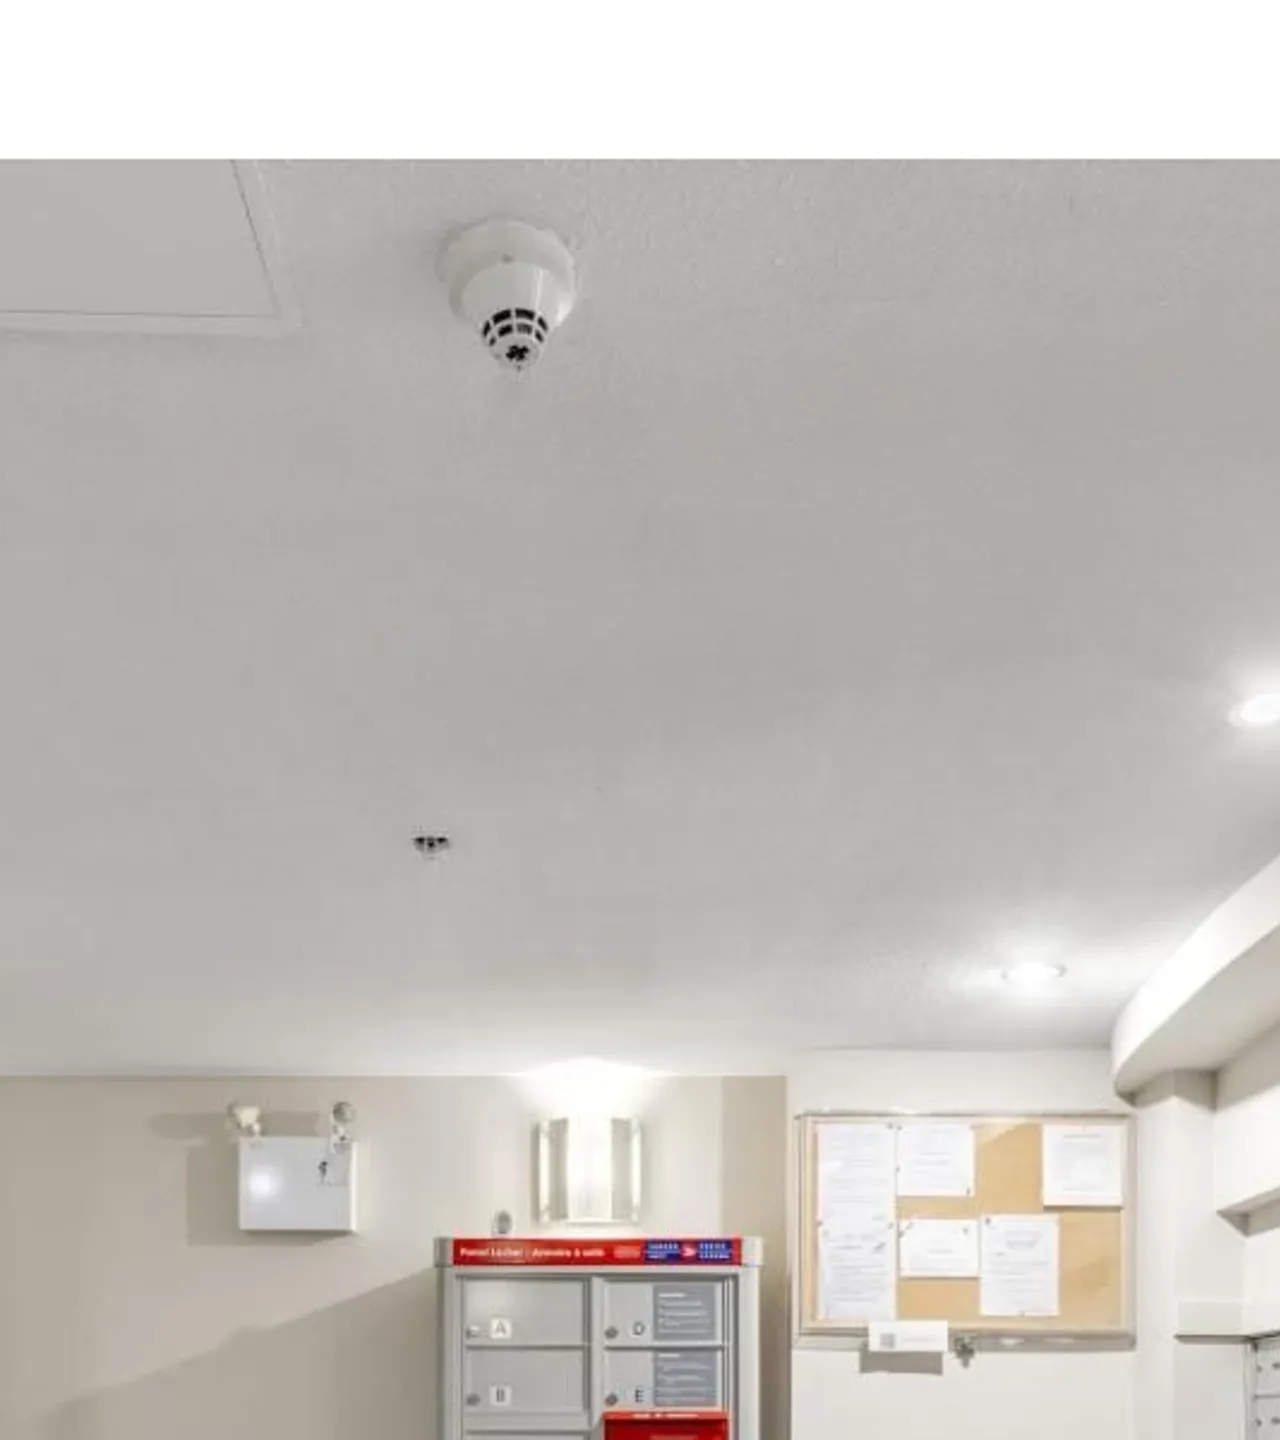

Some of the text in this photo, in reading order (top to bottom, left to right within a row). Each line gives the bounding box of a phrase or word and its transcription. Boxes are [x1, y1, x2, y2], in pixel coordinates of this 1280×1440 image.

[495, 1322, 506, 1335] A
[633, 1321, 645, 1336] D
[635, 1389, 644, 1403] E
